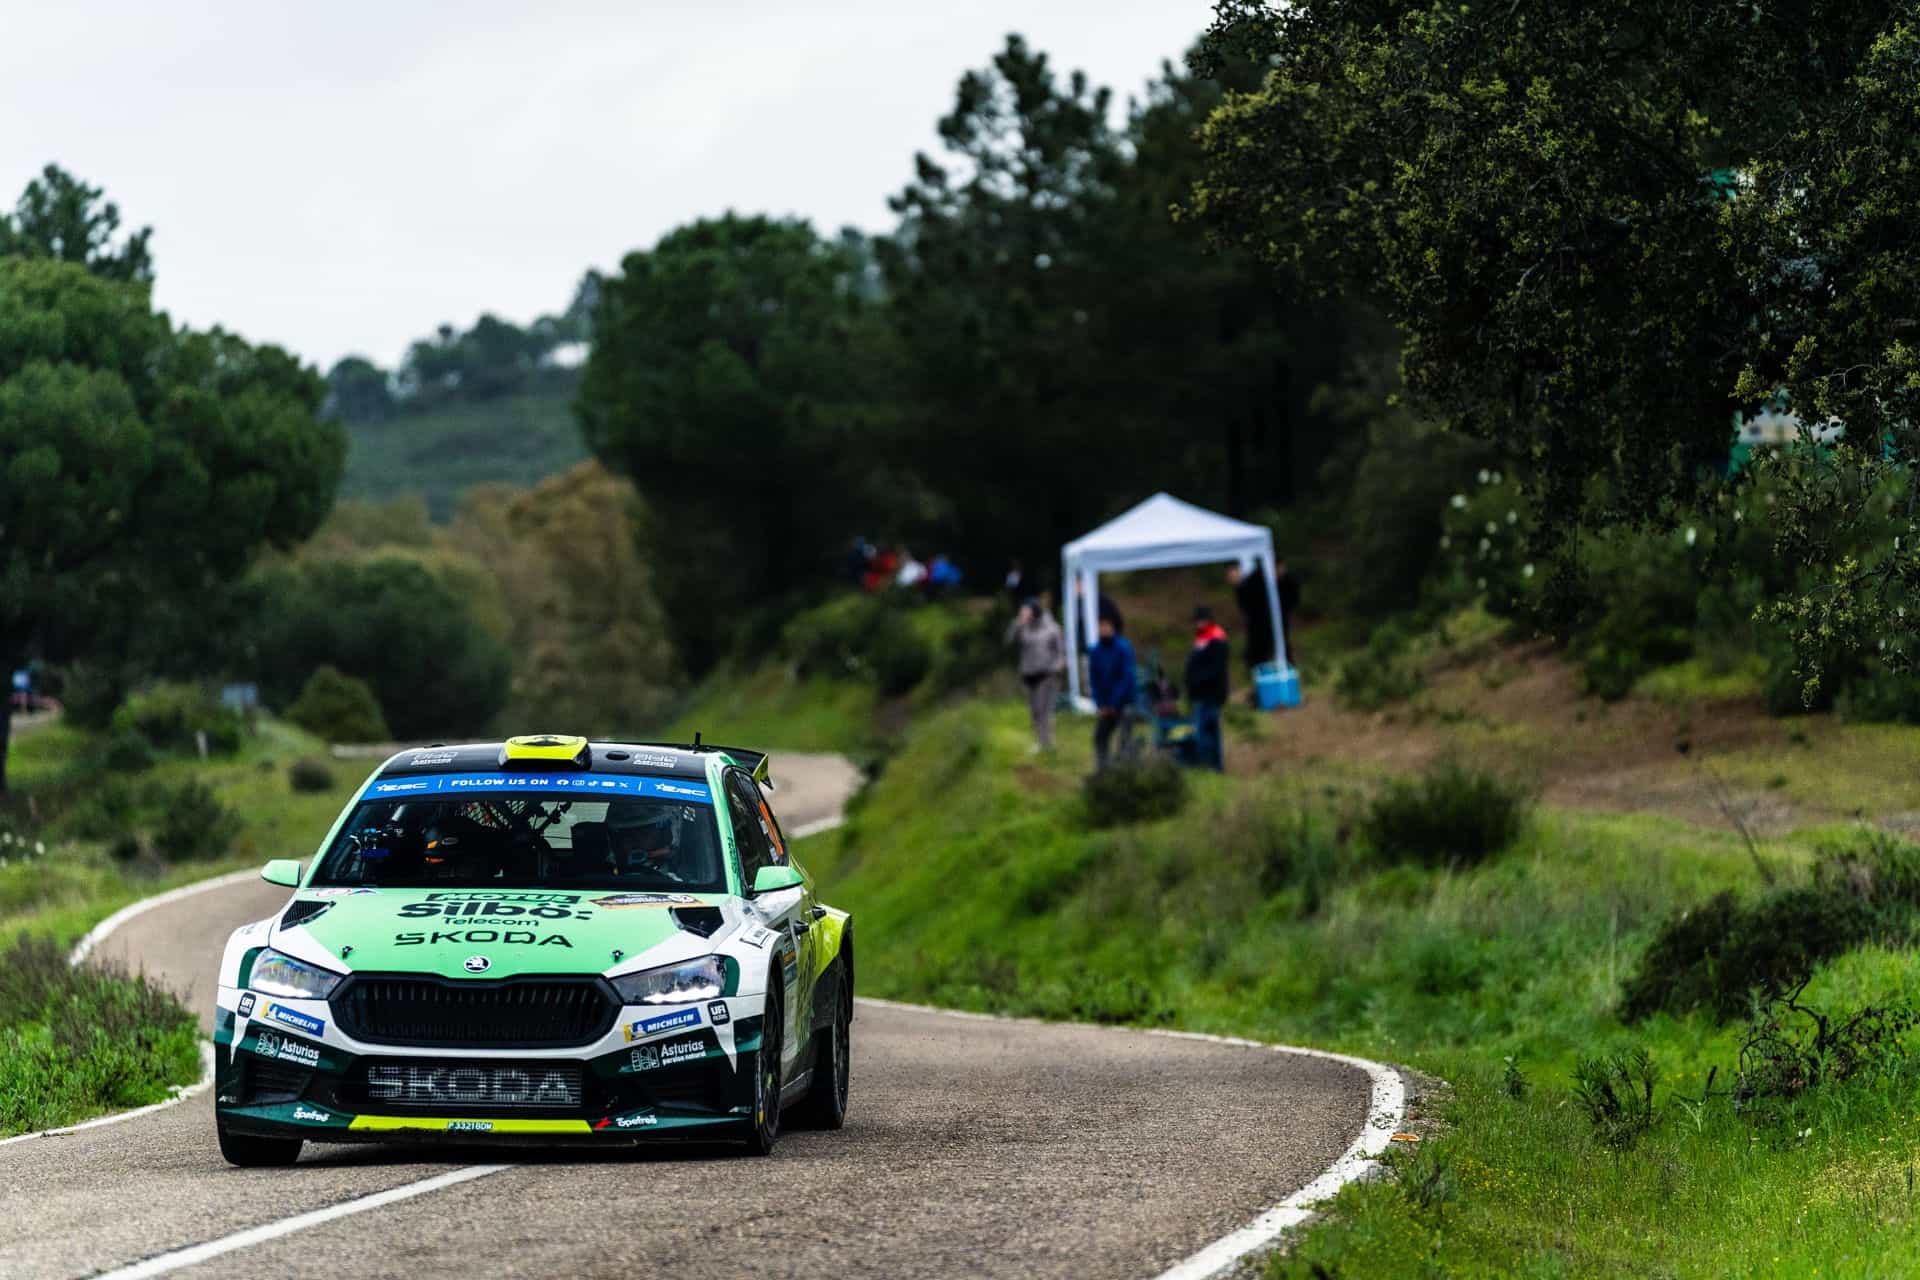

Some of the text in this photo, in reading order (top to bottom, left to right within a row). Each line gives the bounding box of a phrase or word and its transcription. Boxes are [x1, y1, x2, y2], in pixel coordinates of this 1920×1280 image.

[431, 893, 574, 904] MOTUL
[442, 916, 540, 927] Telecom
[277, 1011, 319, 1031] MICHELIN
[647, 1014, 695, 1032] MICHELIN
[280, 1037, 320, 1059] Asturias
[660, 1040, 704, 1058] Asturias
